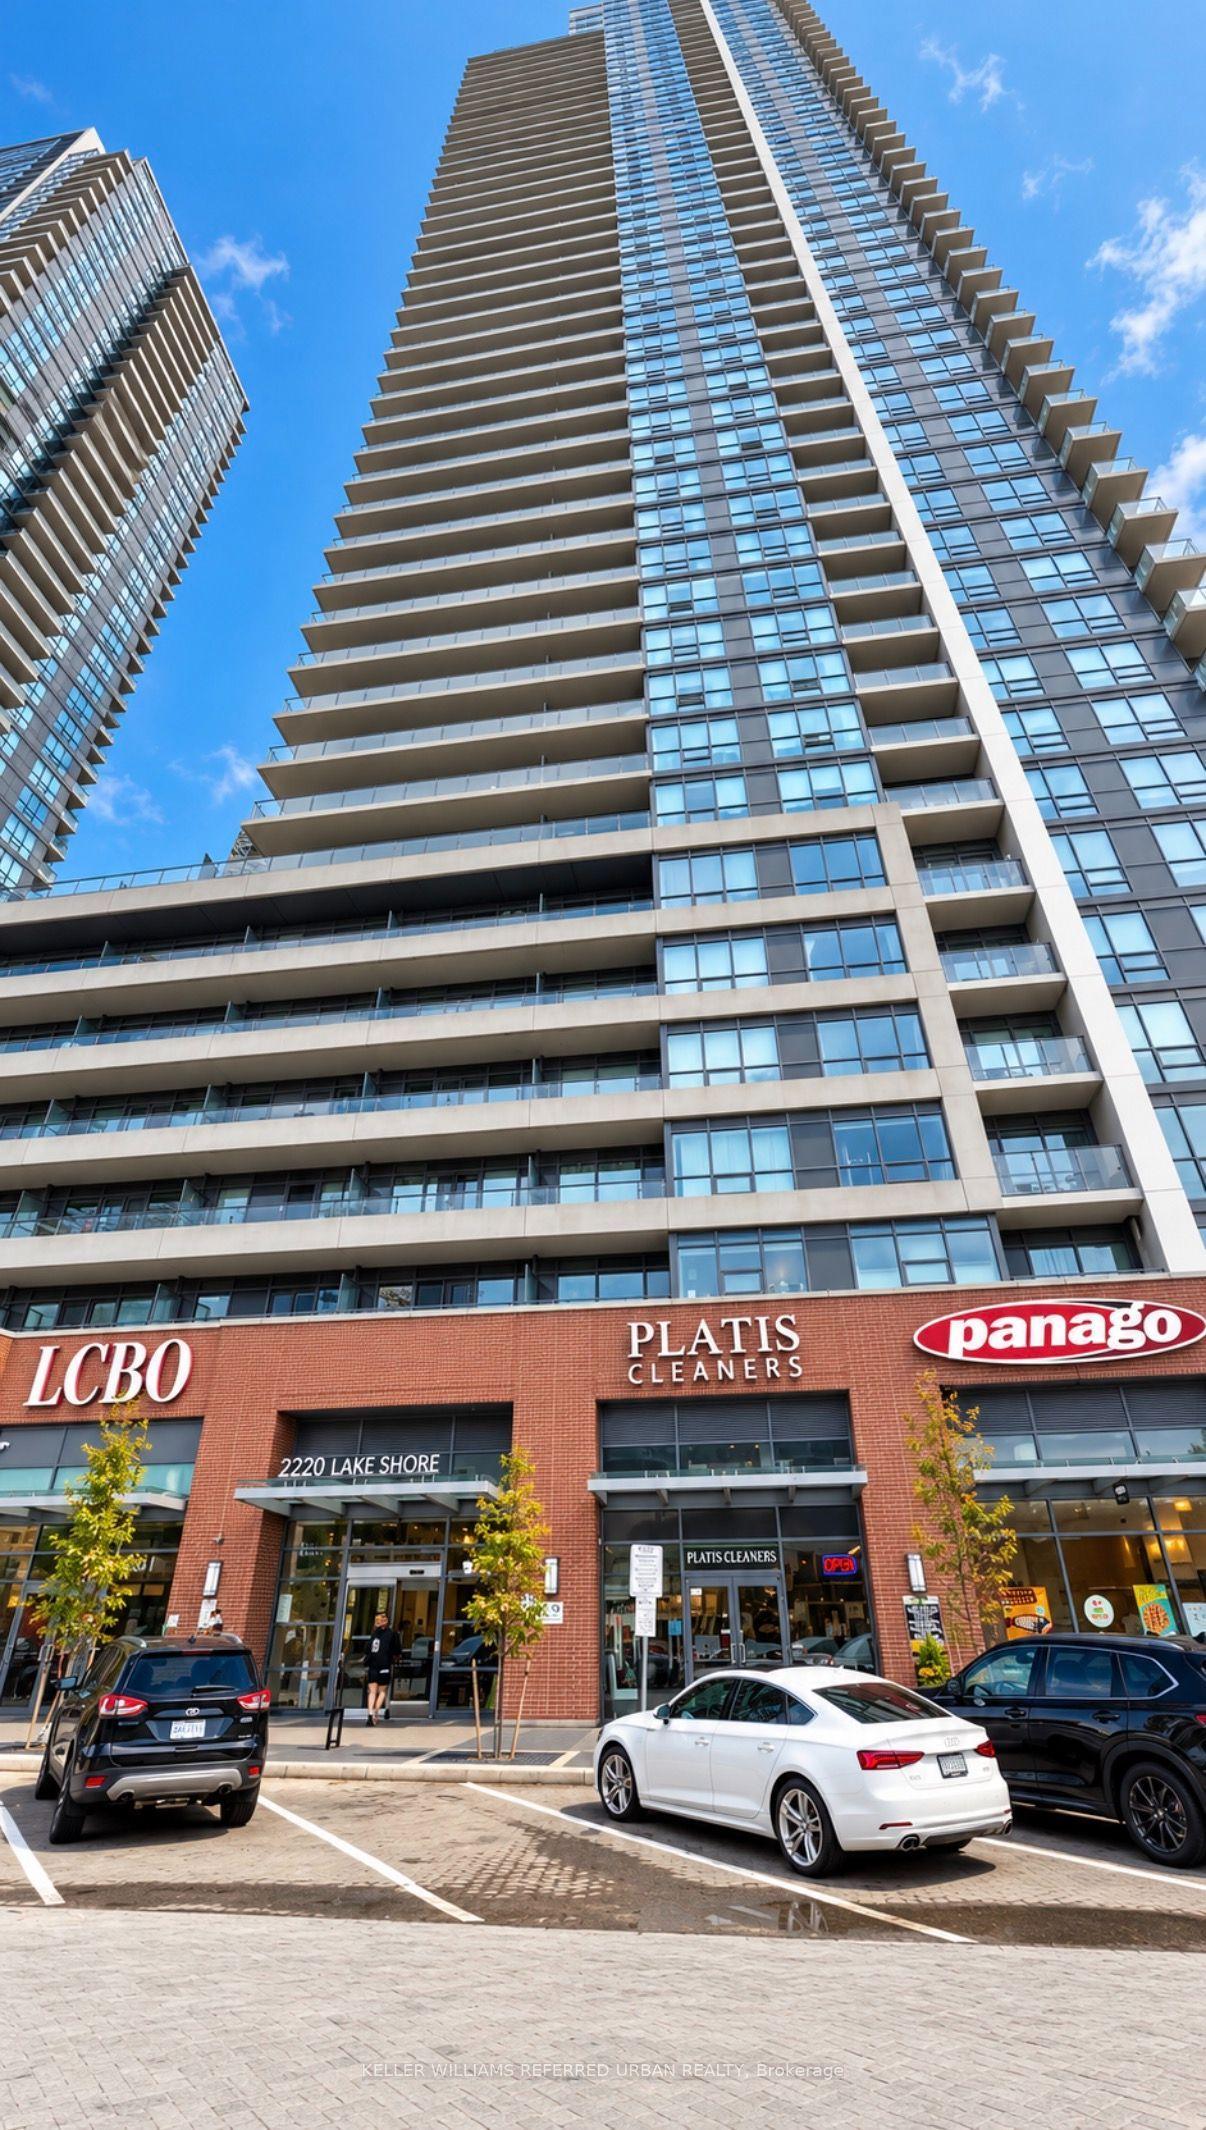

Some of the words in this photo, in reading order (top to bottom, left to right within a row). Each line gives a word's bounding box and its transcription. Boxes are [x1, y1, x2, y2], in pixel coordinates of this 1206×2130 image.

[627, 1314, 800, 1358] PLATIS
[948, 1301, 1182, 1359] panago
[22, 1338, 192, 1406] LCBO
[628, 1356, 803, 1384] CLEANERS
[278, 1457, 325, 1478] 2220
[331, 1456, 375, 1476] LAKE
[379, 1454, 440, 1475] SHORE
[686, 1550, 723, 1564] PLATIS
[724, 1550, 777, 1564] CLEANERS
